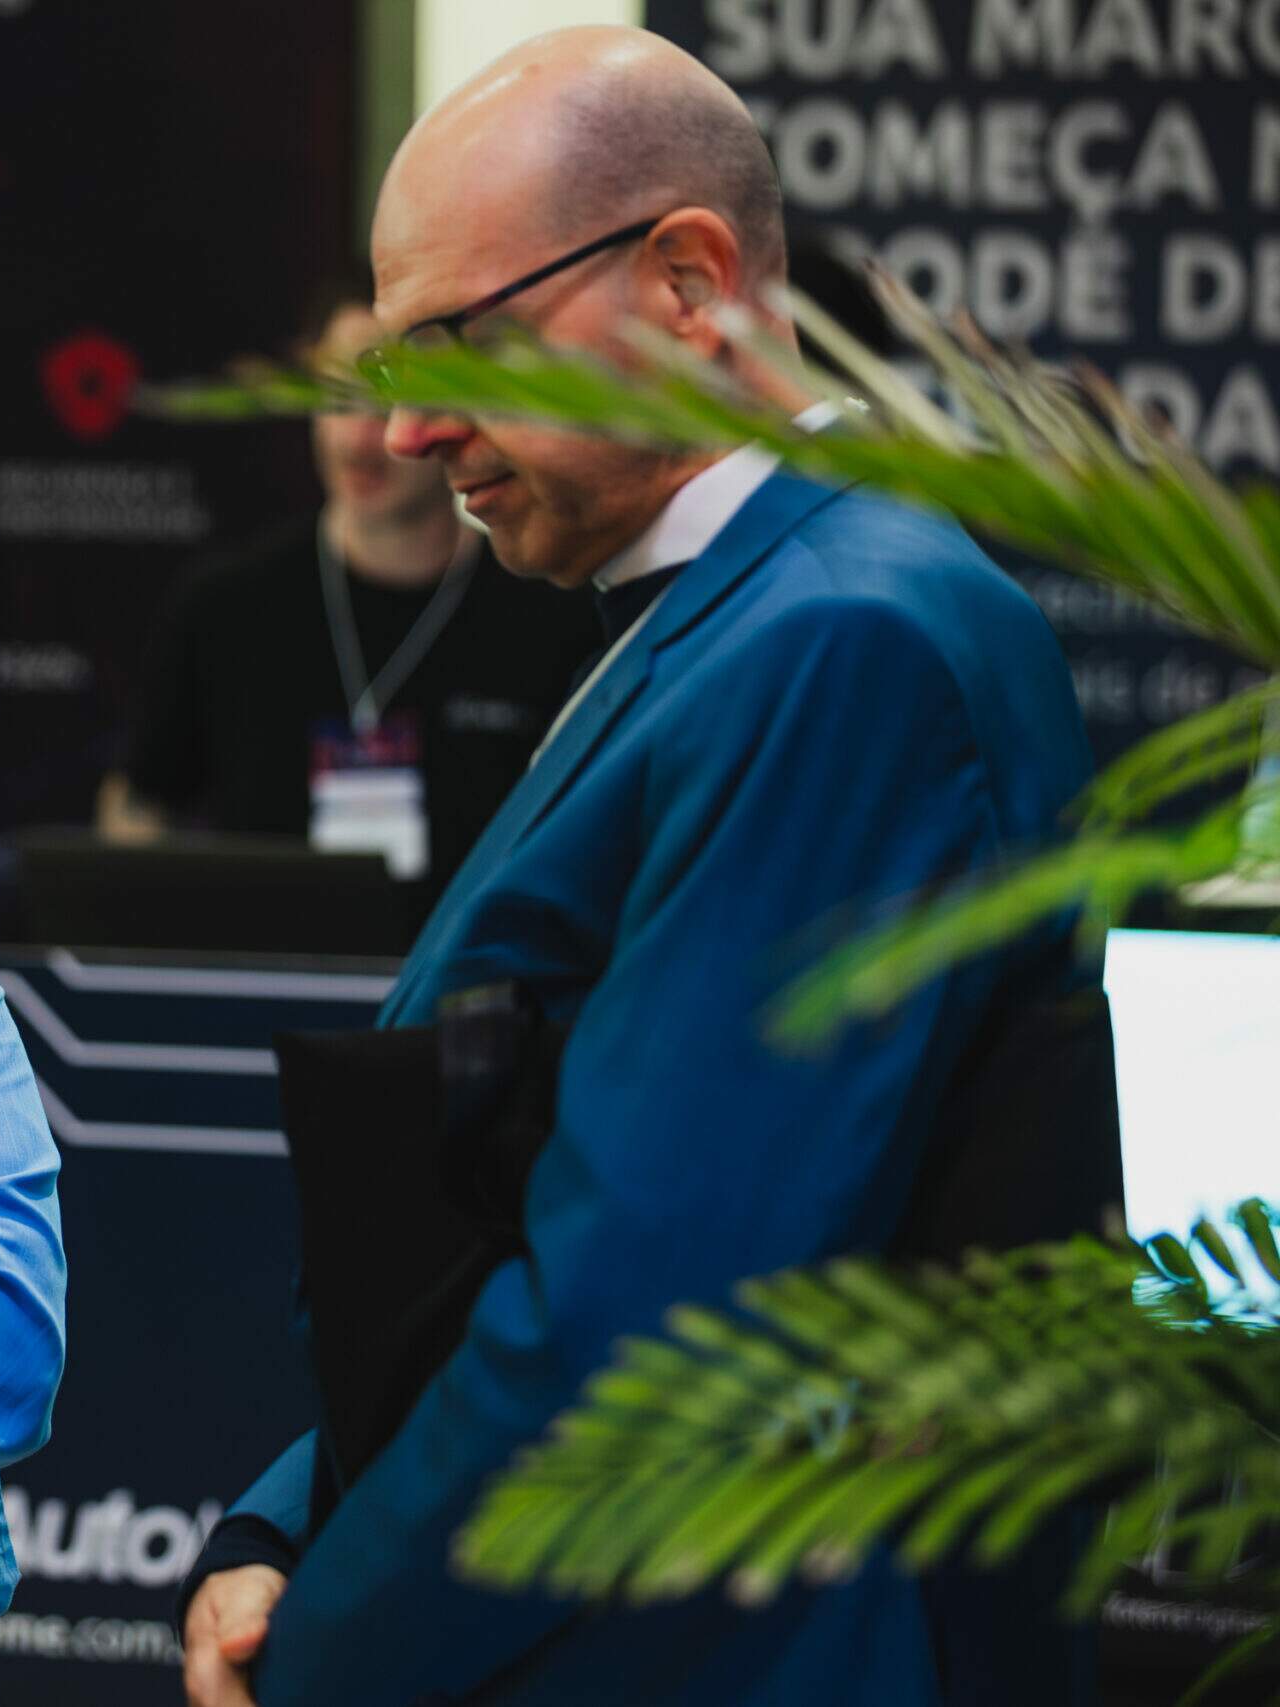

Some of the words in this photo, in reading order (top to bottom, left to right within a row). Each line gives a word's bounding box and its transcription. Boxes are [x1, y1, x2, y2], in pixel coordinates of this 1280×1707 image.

[750, 102, 1220, 224] OMEÇA
[830, 228, 1132, 342] ODE
[2, 1487, 223, 1587] uto
